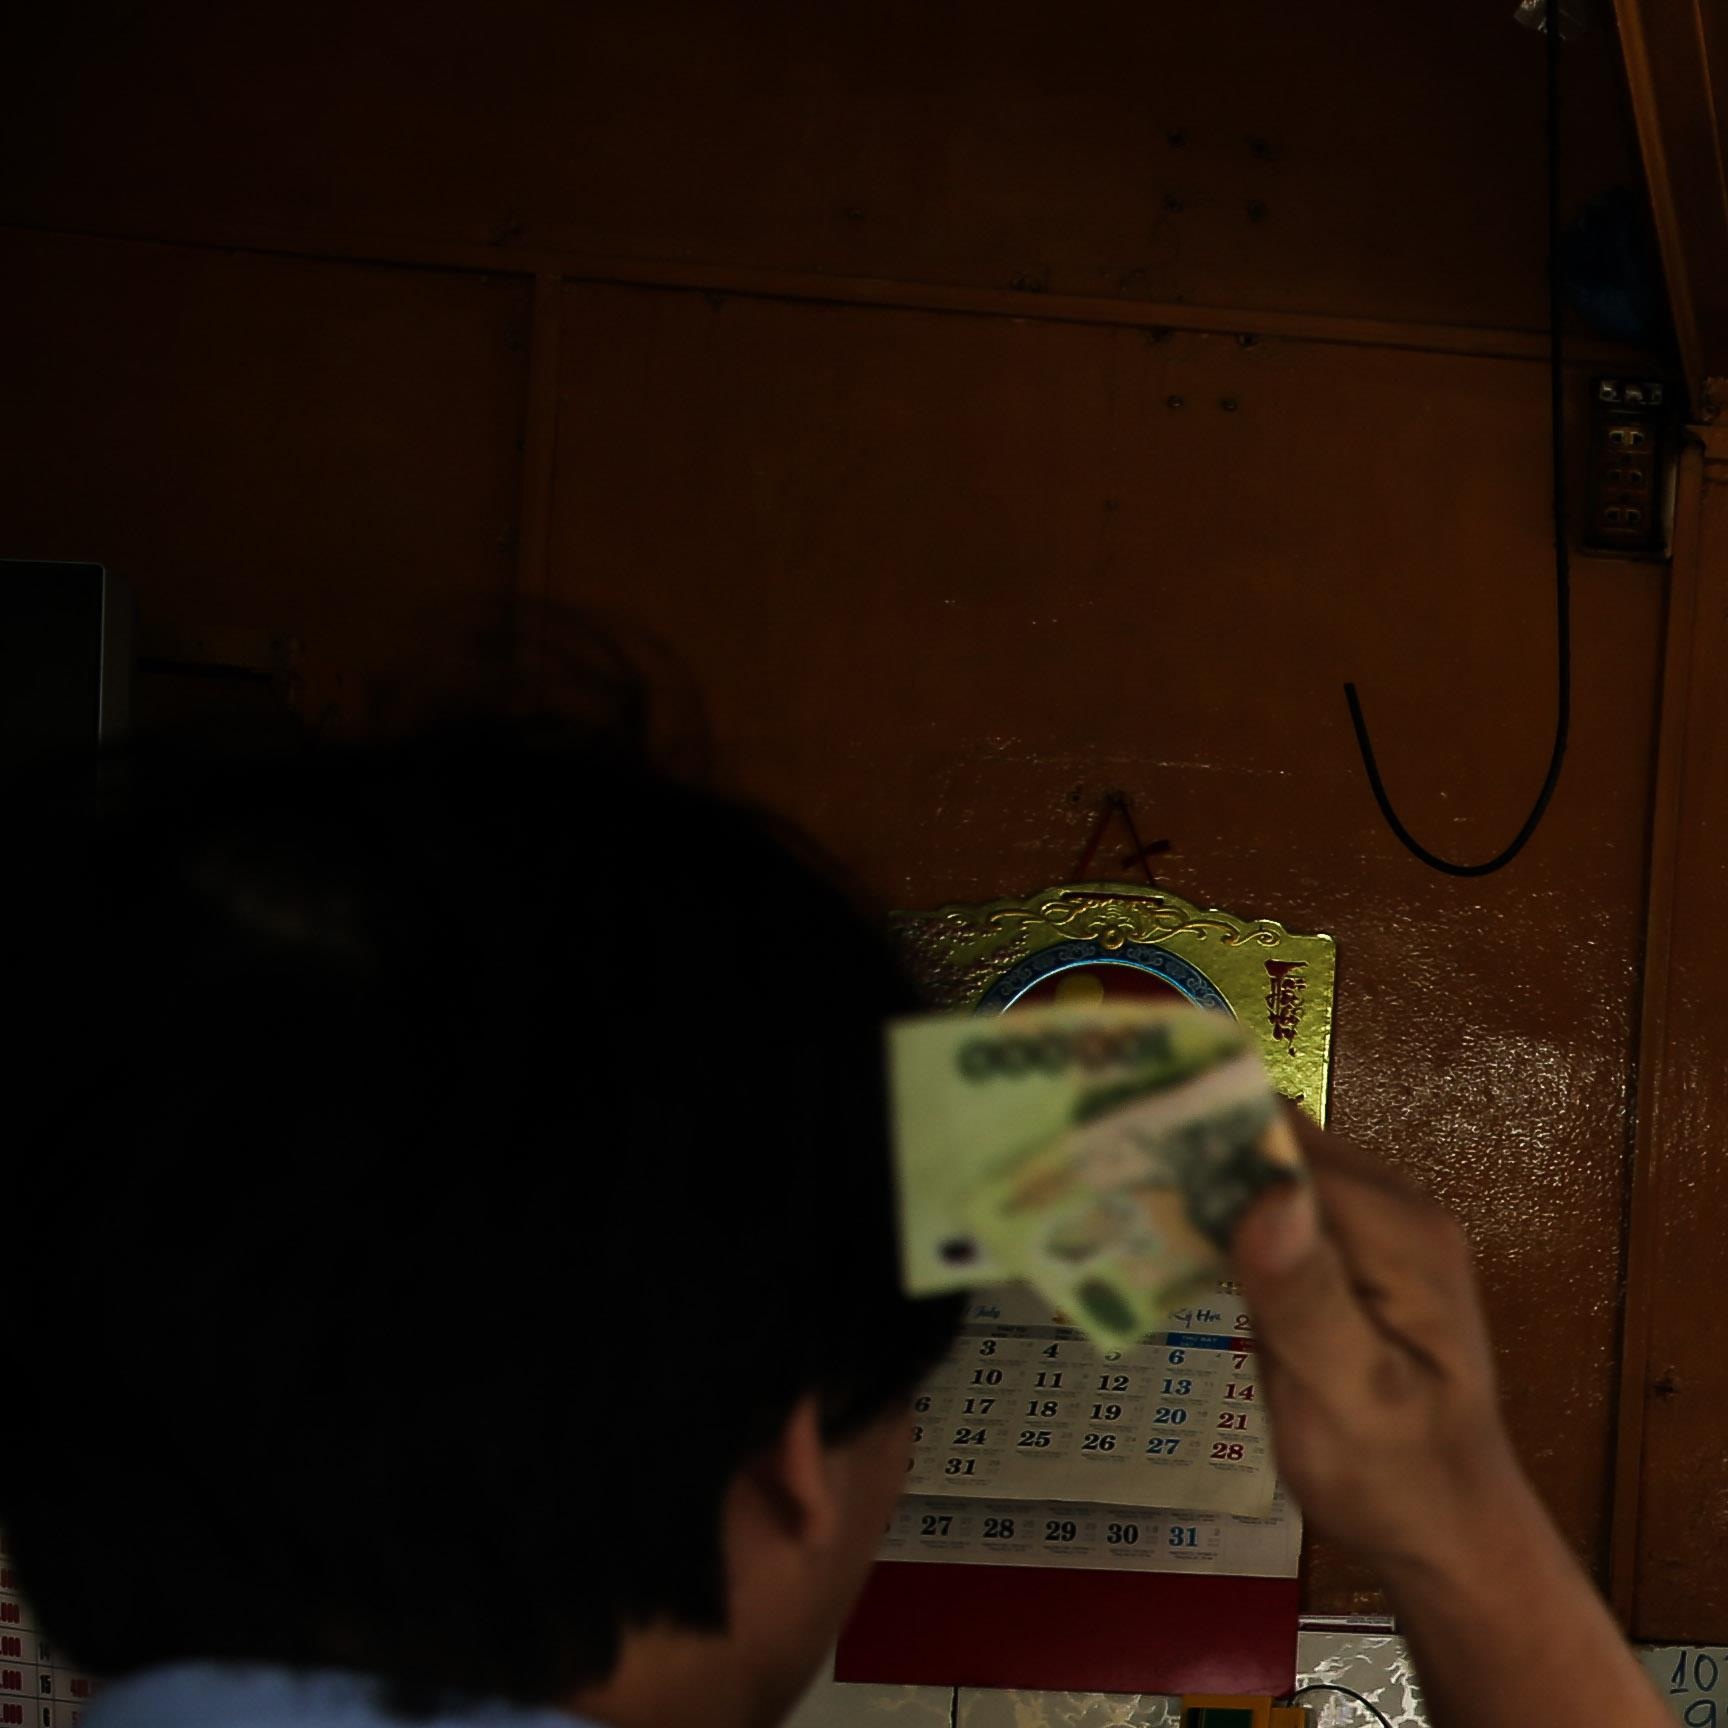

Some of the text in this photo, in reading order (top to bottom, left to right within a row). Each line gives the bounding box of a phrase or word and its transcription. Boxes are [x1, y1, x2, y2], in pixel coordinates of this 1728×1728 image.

[979, 1339, 997, 1356] 3
[1043, 1342, 1060, 1359] 4
[1168, 1349, 1185, 1365] 6
[1231, 1353, 1248, 1370] 7
[970, 1369, 1255, 1400] 10 11 12 13 14
[963, 1398, 995, 1415] 17
[1026, 1401, 1058, 1418] 18
[1090, 1404, 1122, 1421] 19
[1153, 1407, 1187, 1425] 20
[1217, 1412, 1248, 1431] 21
[953, 1428, 986, 1446] 24
[1017, 1430, 1051, 1448] 25
[1081, 1433, 1116, 1451] 26
[1147, 1437, 1181, 1455] 27
[1210, 1442, 1244, 1461] 28
[945, 1458, 976, 1476] 31
[920, 1515, 953, 1537] 27
[982, 1518, 1015, 1539] 28
[1044, 1520, 1077, 1542] 29
[1106, 1523, 1138, 1545] 30
[1168, 1526, 1198, 1547] 31
